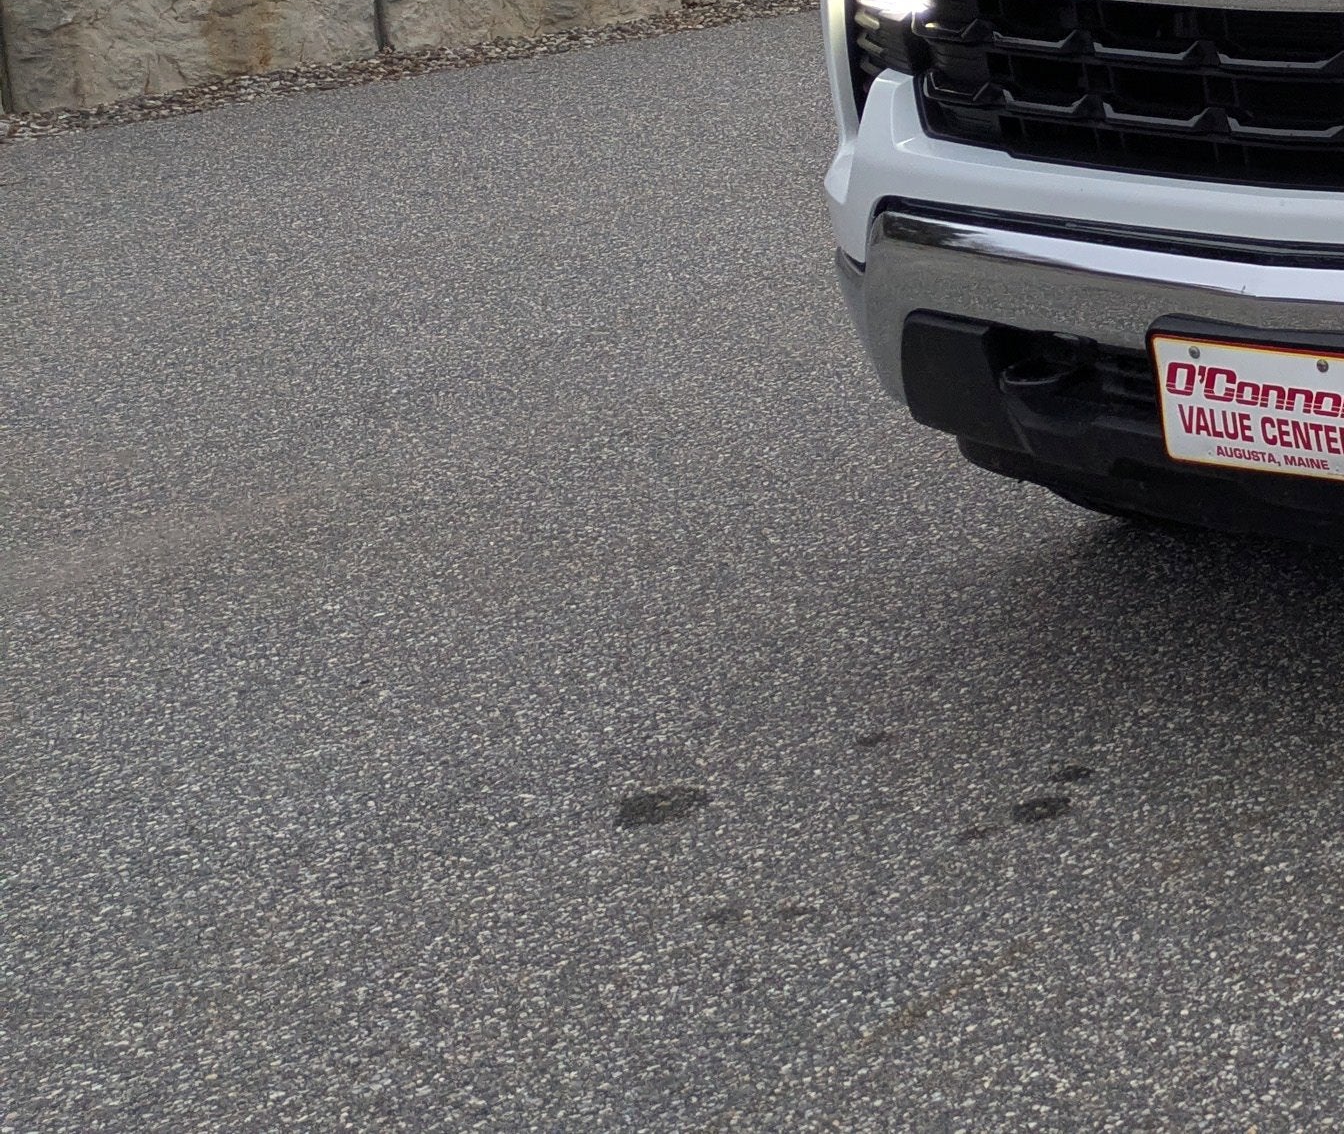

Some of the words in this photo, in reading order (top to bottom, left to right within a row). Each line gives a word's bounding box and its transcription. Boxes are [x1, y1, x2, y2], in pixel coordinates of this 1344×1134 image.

[1177, 403, 1255, 443] VALUE
[1216, 445, 1282, 467] AUGUSTA,
[1284, 454, 1331, 471] MAINE
